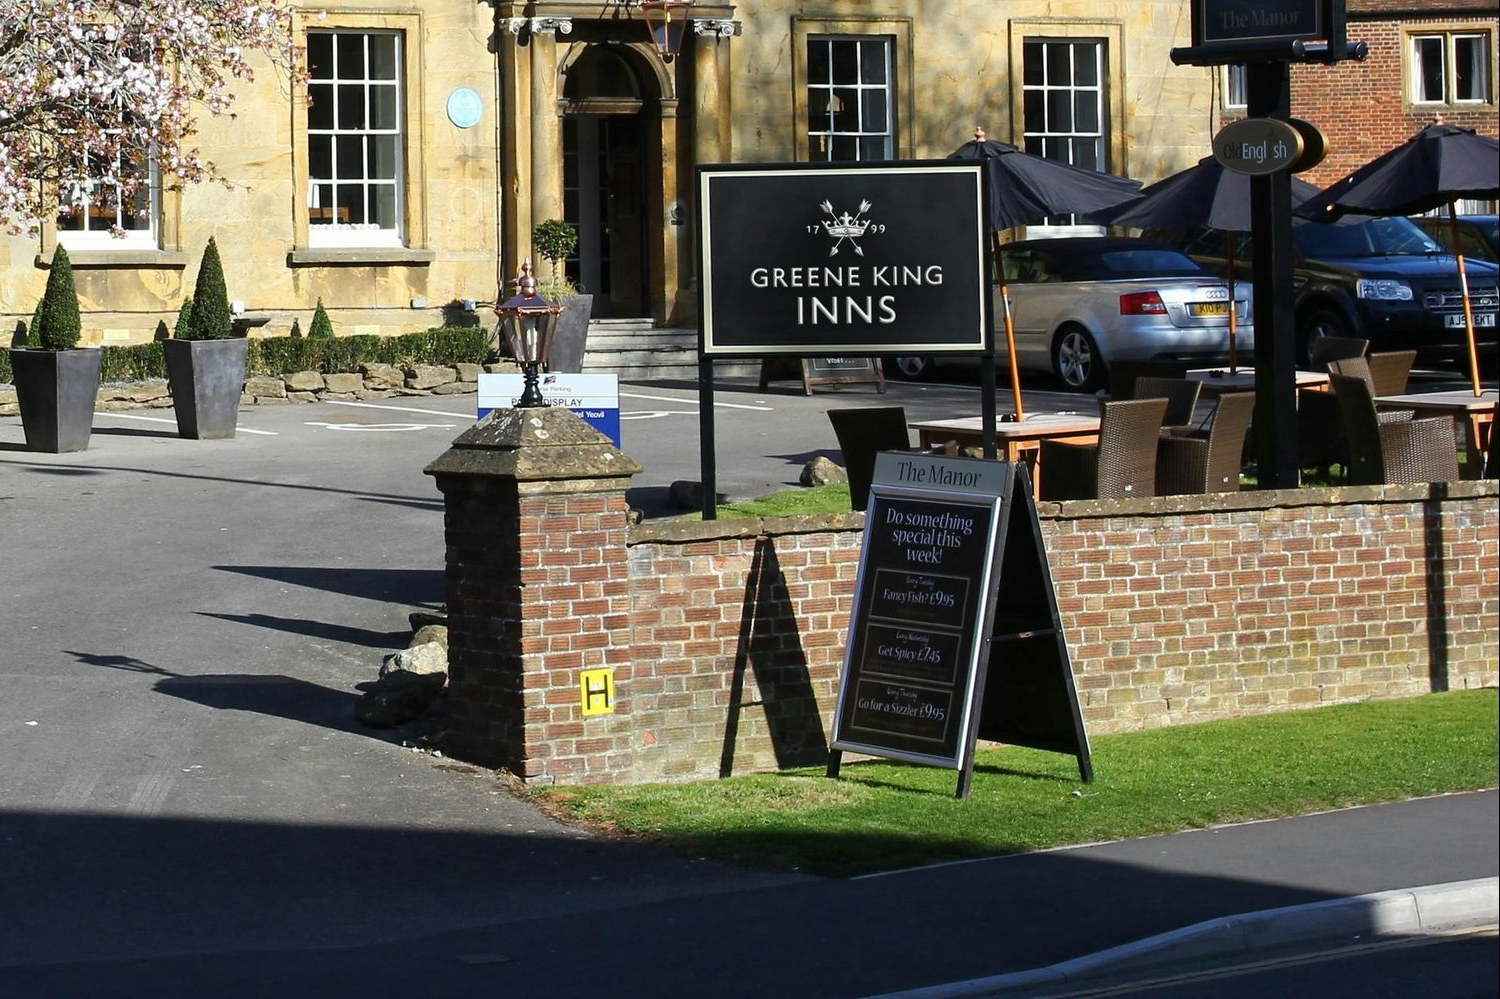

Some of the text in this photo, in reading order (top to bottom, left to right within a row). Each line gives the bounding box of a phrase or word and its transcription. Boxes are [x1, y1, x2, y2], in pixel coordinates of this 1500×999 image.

[1220, 8, 1300, 29] The Manor
[806, 224, 886, 235] 17 99
[750, 265, 943, 288] GREENE KING
[797, 295, 897, 325] INNS
[543, 398, 582, 407] DISPLAY
[898, 461, 982, 488] The Manor
[886, 508, 973, 536] Do something
[892, 528, 961, 548] special this
[906, 547, 943, 564] week!
[883, 588, 907, 604] Fancy
[878, 644, 892, 657] Get
[894, 646, 917, 662] Spicy
[585, 674, 609, 710] H
[858, 698, 869, 709] Go
[870, 698, 883, 711] for
[883, 703, 890, 712] a
[891, 702, 918, 717] Sizzler
